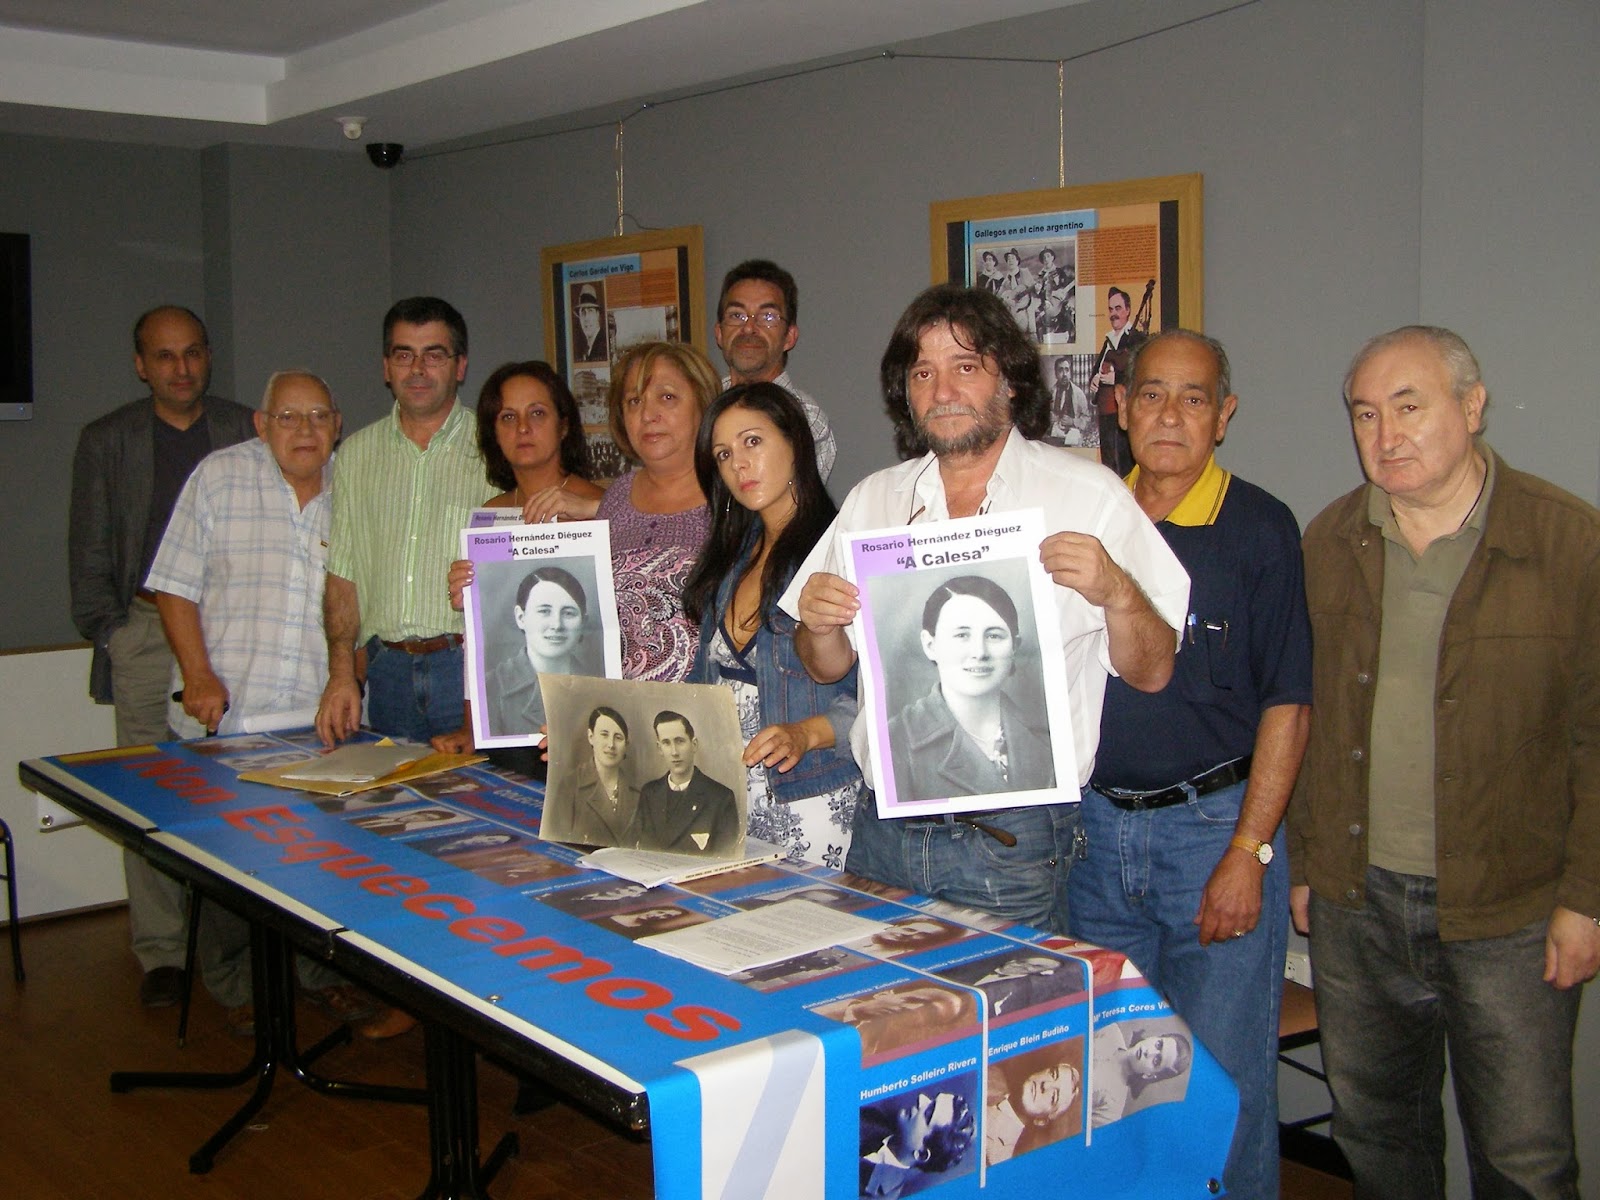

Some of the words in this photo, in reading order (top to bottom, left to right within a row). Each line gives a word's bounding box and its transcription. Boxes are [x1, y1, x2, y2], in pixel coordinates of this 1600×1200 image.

[975, 228, 1006, 239] Gallegos
[1008, 227, 1017, 235] en
[1019, 225, 1027, 234] el
[1028, 224, 1044, 233] cine
[1046, 221, 1084, 232] argentino
[570, 269, 588, 278] Carlos
[590, 268, 609, 276] Gardel
[619, 264, 634, 274] Vigo
[474, 536, 506, 544] Rosario
[508, 532, 556, 542] Hernández
[558, 530, 592, 540] Diéguez
[862, 540, 904, 552] Rosario
[907, 530, 971, 547] Hernández
[974, 524, 1022, 537] Diéguez
[522, 546, 559, 556] Calesa”
[896, 556, 917, 569] “A
[922, 546, 990, 566] Calesa”
[123, 758, 238, 805] Non
[220, 803, 742, 1042] Esquecemos
[1102, 1006, 1126, 1018] Teresa
[1128, 1004, 1155, 1012] Cores
[988, 1040, 1018, 1057] Enrique
[1020, 1034, 1040, 1047] Blein
[1042, 1025, 1070, 1039] Budiño
[860, 1078, 908, 1100] Humberto
[910, 1066, 946, 1084] Solleiro
[948, 1056, 977, 1072] Rivera
